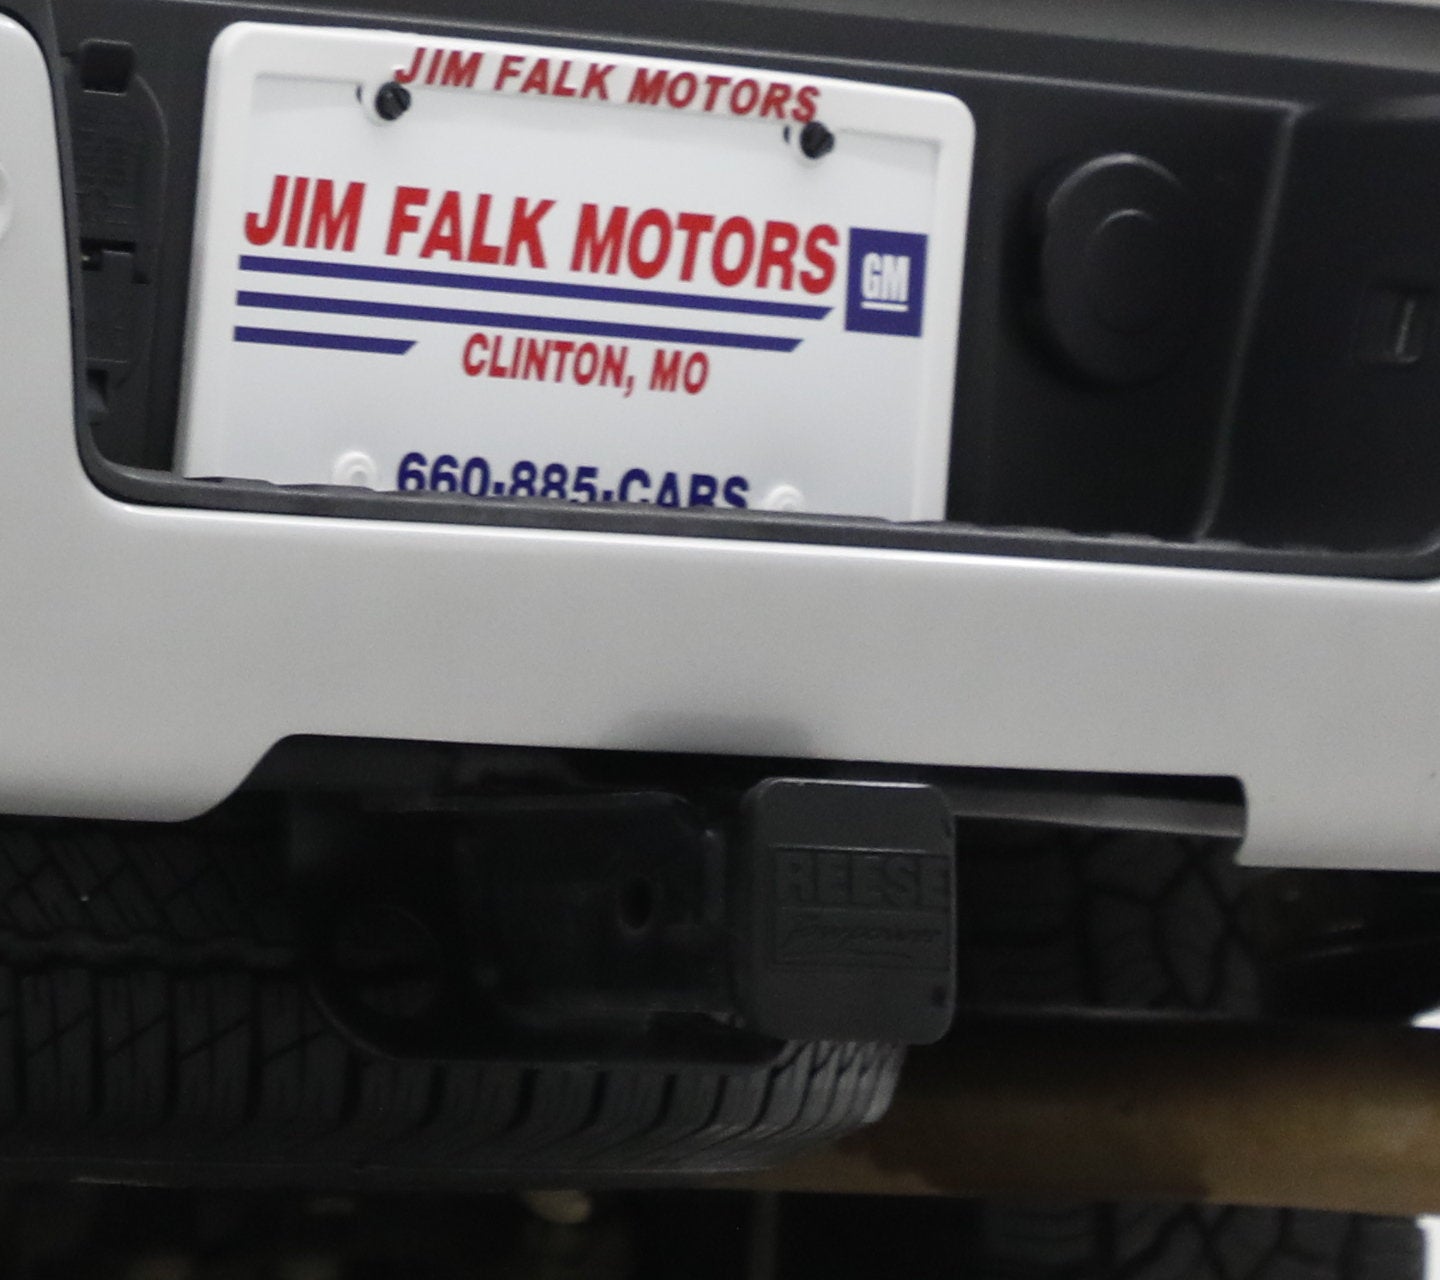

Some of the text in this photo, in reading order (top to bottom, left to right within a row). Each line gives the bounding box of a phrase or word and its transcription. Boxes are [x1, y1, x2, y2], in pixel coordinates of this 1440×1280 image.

[395, 47, 820, 123] JIM FALK MOTORS
[244, 174, 840, 295] JIM FALK MOTORS
[862, 252, 910, 302] GM
[462, 333, 709, 397] CLINTON, MO
